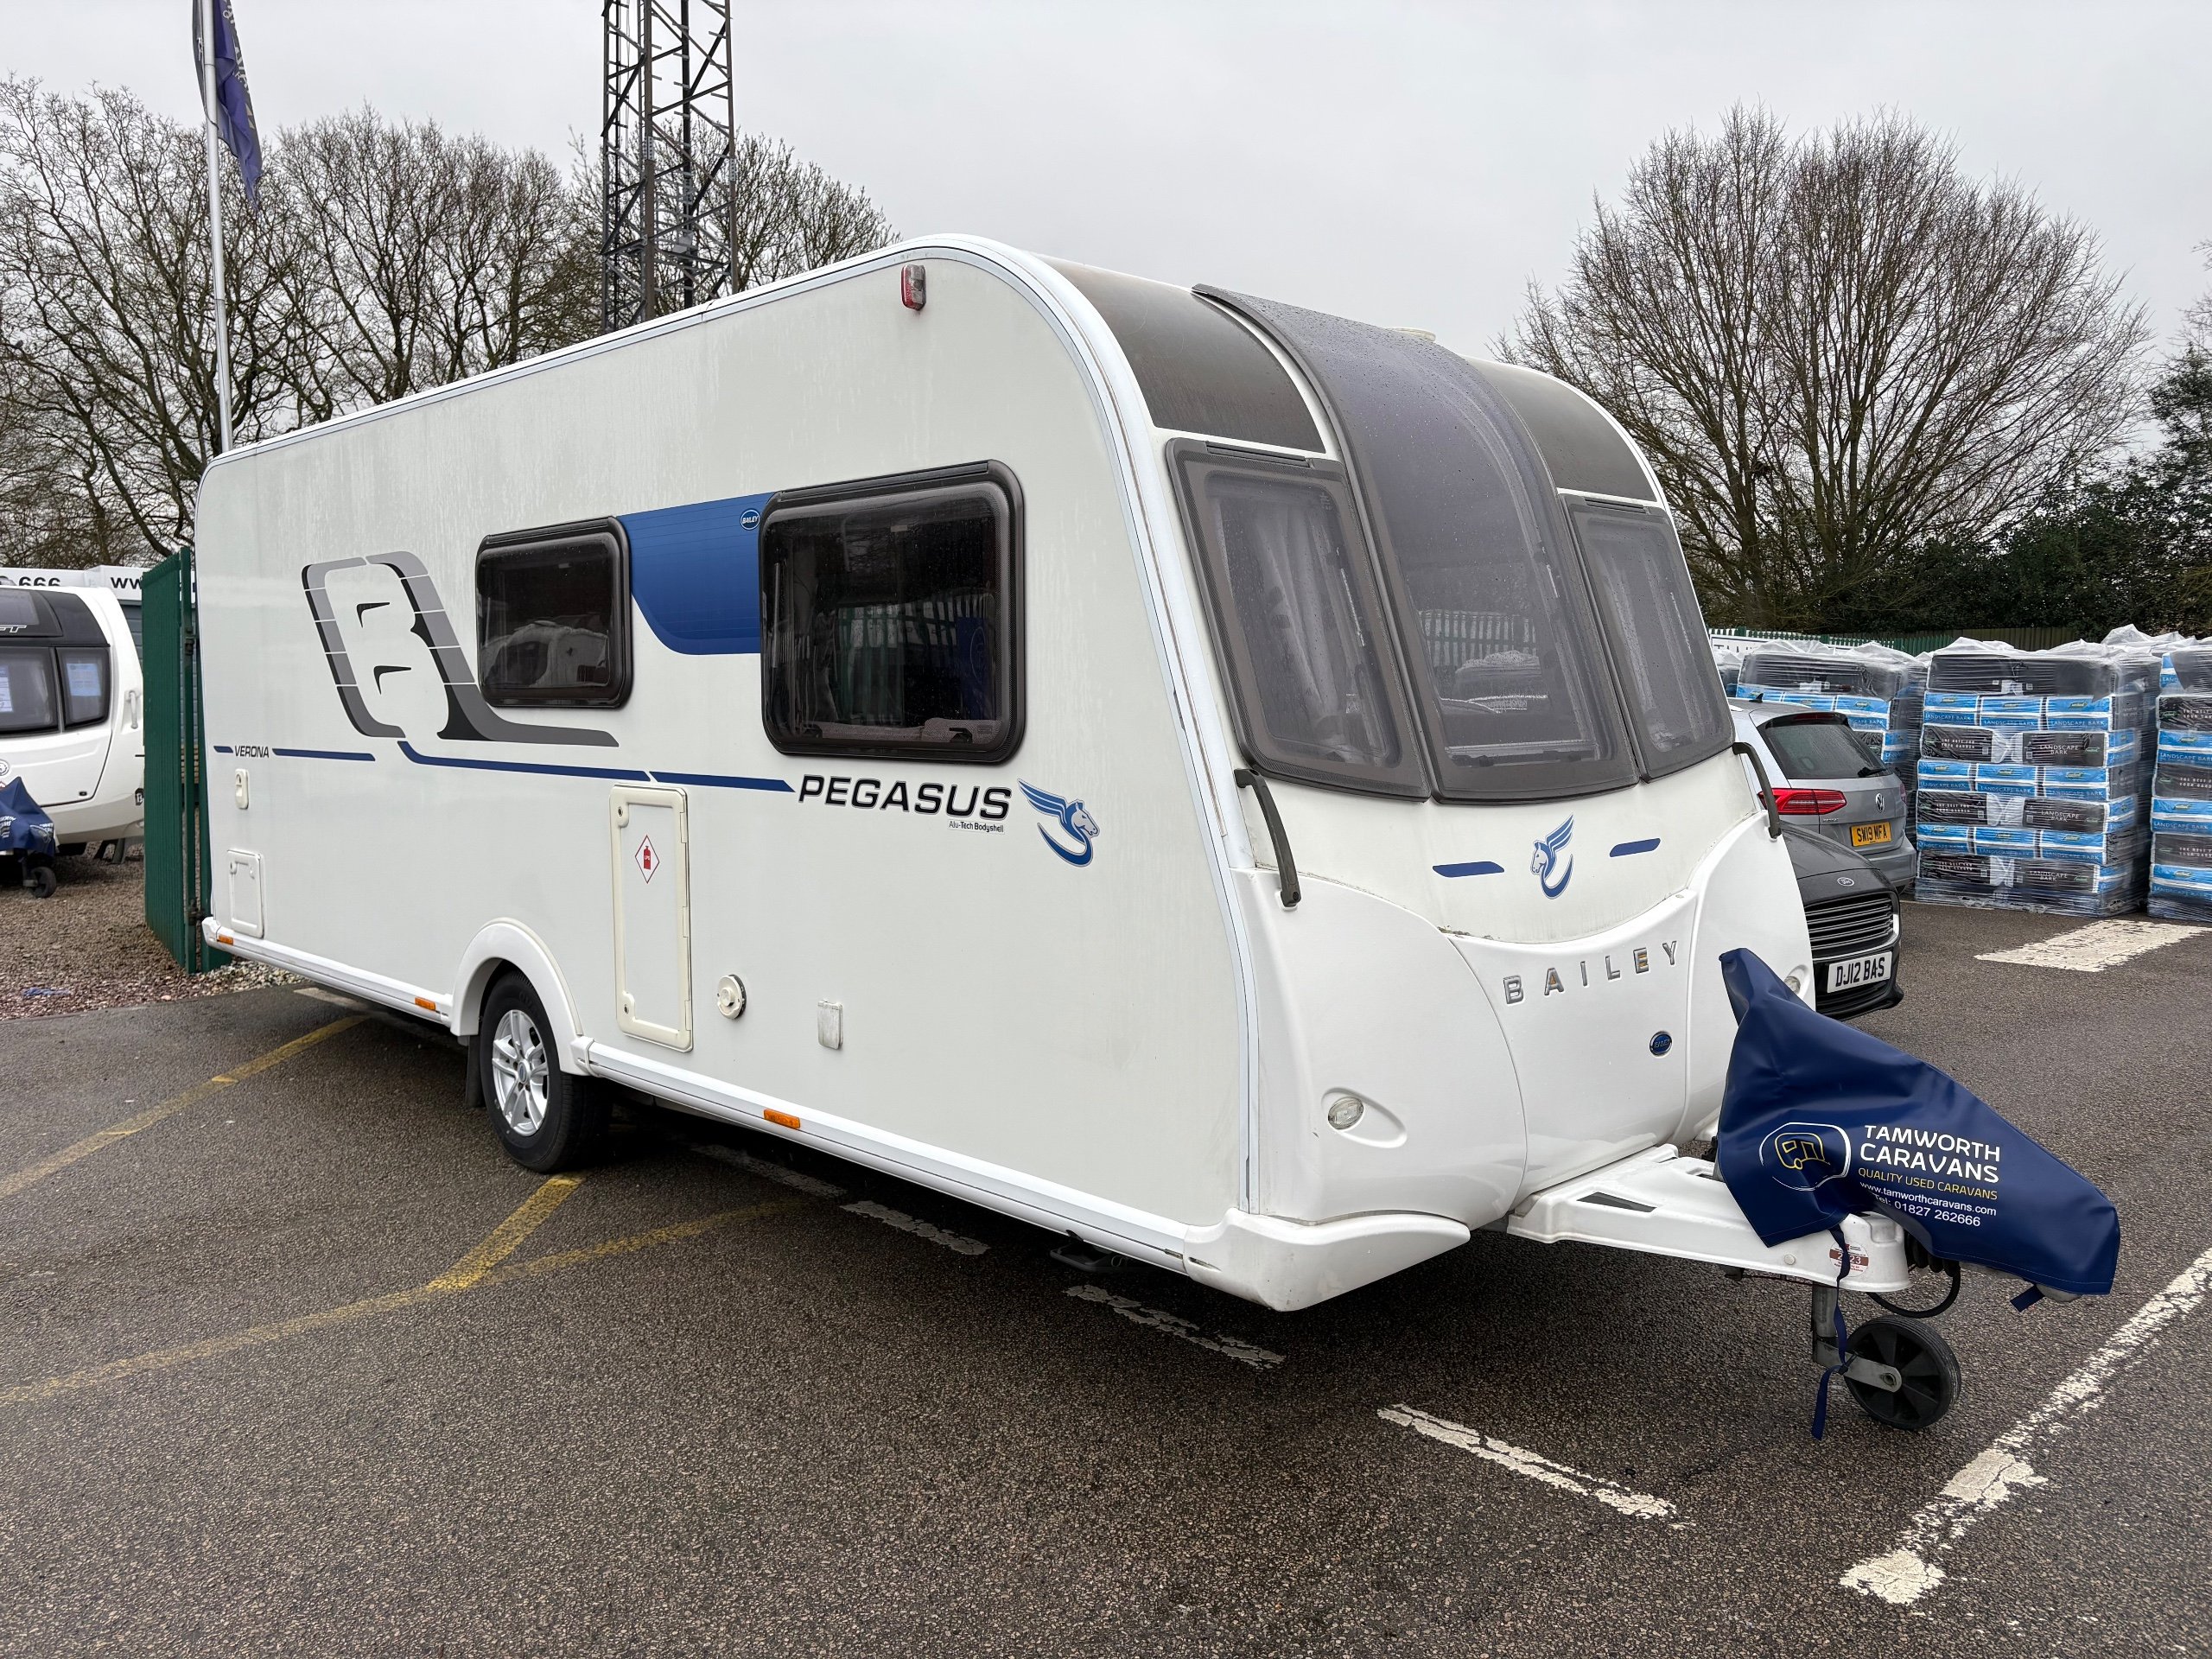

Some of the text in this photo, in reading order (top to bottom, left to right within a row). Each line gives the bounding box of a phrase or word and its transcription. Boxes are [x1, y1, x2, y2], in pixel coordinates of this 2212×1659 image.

[741, 515, 759, 524] BAILEY
[234, 745, 270, 758] VERONA
[798, 773, 1013, 821] PEGASUS
[949, 821, 1005, 833] Alu-Tech Bodyshell
[2041, 810, 2080, 819] LANDSCAPE
[2030, 870, 2068, 879] LANDSCAPE
[1503, 940, 1677, 1005] BAILEY
[1835, 957, 1885, 987] DJ12 BAS
[1865, 1125, 2000, 1161] TAMWORTH
[1860, 1143, 1999, 1183] CARAVANS
[1858, 1167, 1998, 1200] QUALITY USED CARAVANS
[1859, 1181, 1997, 1216] www.tamworthcaravans.com
[1894, 1200, 1931, 1217] 01827
[1934, 1210, 1980, 1227] 262666
